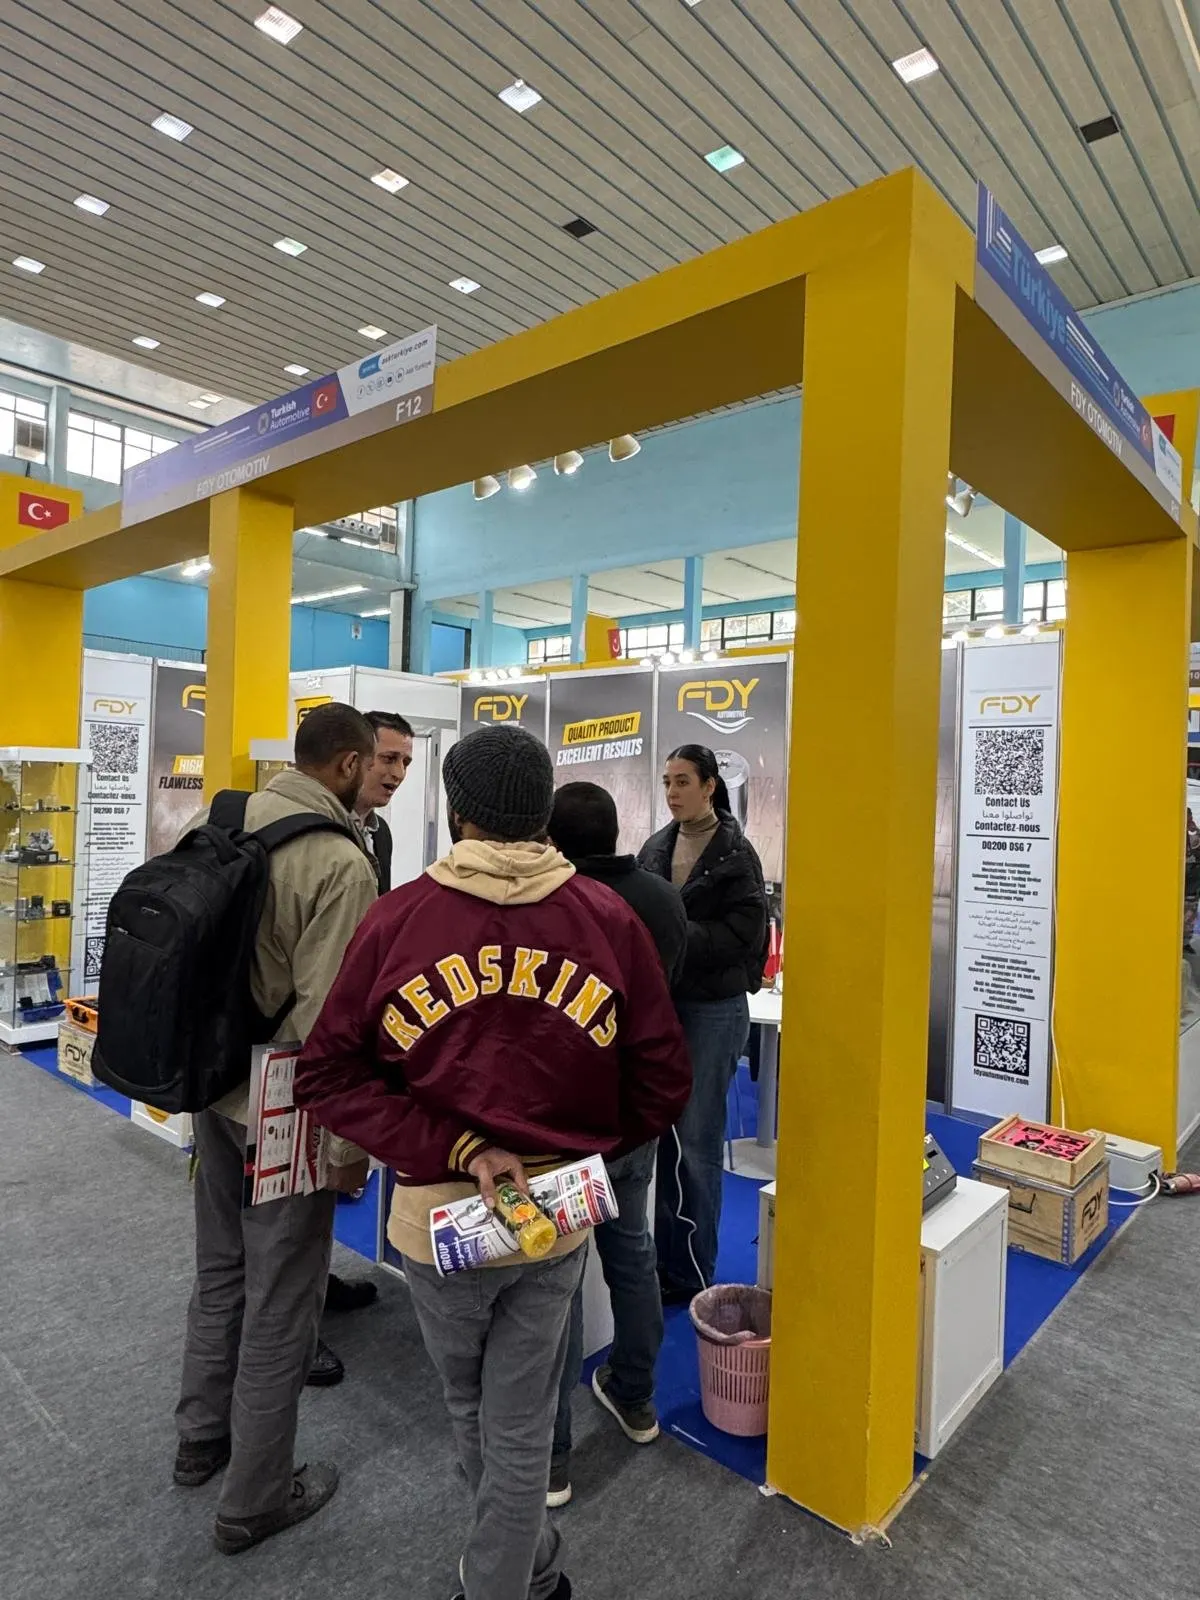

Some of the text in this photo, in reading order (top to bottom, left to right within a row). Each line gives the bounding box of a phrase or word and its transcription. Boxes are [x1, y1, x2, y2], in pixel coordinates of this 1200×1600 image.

[1012, 243, 1067, 345] Türkiye
[271, 400, 296, 418] Turkish
[271, 407, 310, 429] Automotive
[396, 396, 422, 422] F12
[1071, 381, 1122, 456] FDY OTOMOTIV
[218, 455, 271, 489] OTOMOTIV
[93, 699, 138, 715] FDY
[678, 678, 760, 712] FDY
[980, 694, 1041, 715] FDY
[474, 694, 529, 721] FDY
[567, 717, 636, 743] QUALITY PRODUCT
[556, 738, 643, 767] EXCELLENT RESULTS
[181, 758, 204, 774] HIGH
[159, 776, 204, 790] FLAWLESS
[986, 796, 1031, 808] Contact Us
[975, 820, 1041, 833] Contactez-nous
[982, 810, 1034, 822] تواصلوا معنا
[981, 840, 1033, 853] DQ200 DSG 7
[381, 944, 618, 1052] REDSKINS
[65, 1043, 87, 1065] FDY
[1081, 1187, 1104, 1230] FDY
[438, 1242, 454, 1271] GROUP
